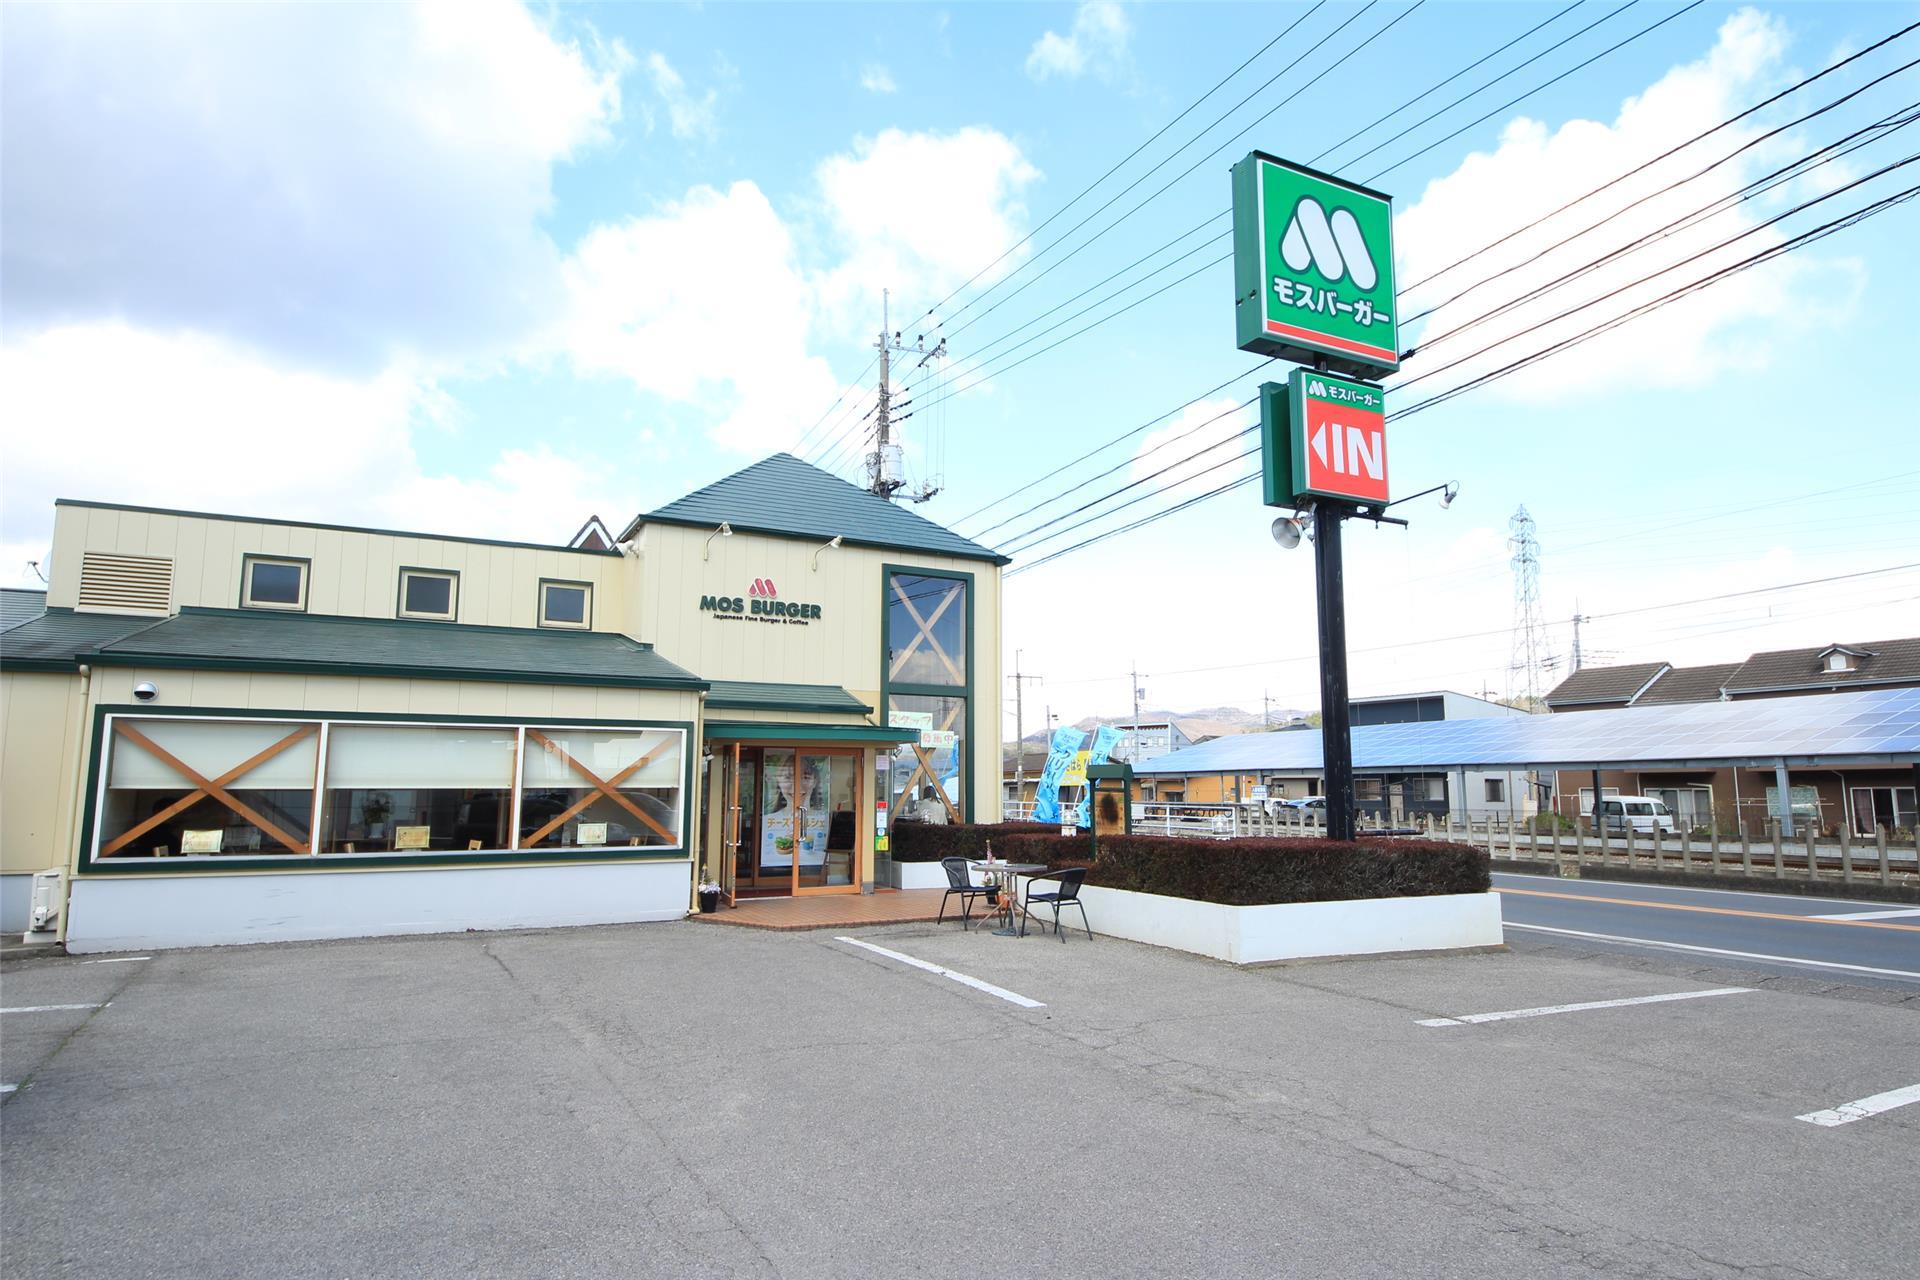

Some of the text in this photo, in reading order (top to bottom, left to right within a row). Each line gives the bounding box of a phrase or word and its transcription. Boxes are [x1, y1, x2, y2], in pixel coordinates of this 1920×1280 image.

[1273, 277, 1390, 326] モスバーガー
[1328, 385, 1381, 406] モスバーガー
[1331, 423, 1384, 481] IN
[699, 595, 822, 619] MOS BURGER
[713, 613, 743, 621] Japanese
[760, 616, 781, 624] Burger
[789, 618, 809, 626] Coffee
